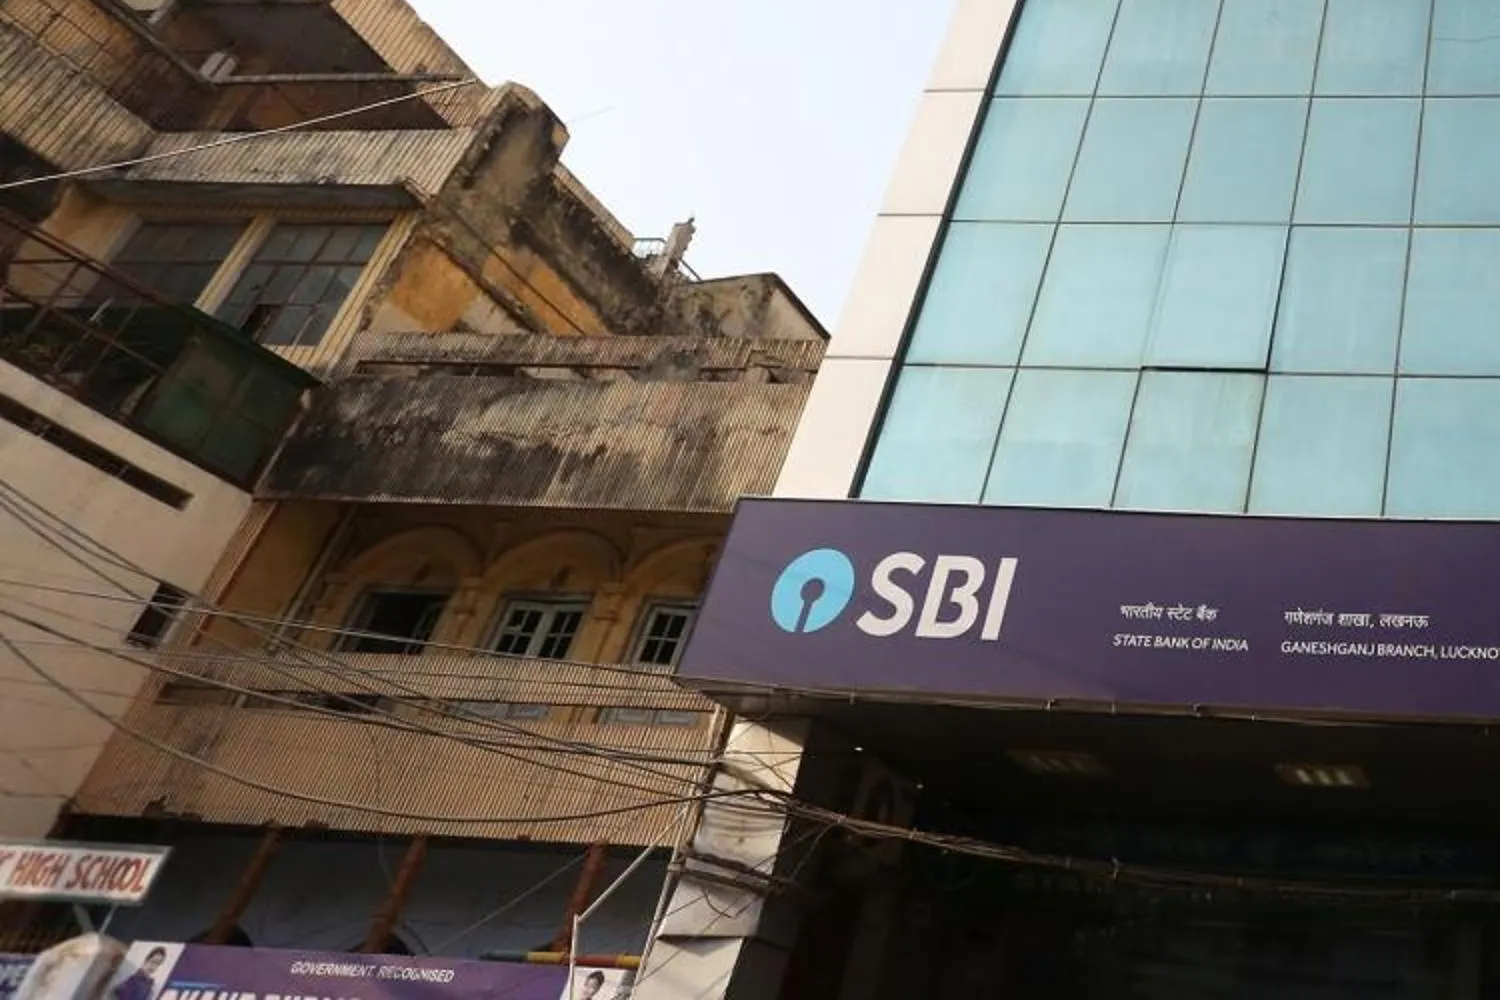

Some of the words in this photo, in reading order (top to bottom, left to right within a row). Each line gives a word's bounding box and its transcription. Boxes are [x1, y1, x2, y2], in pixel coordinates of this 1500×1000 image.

[856, 551, 1018, 640] SBI
[1120, 601, 1164, 620] भारतीय
[1167, 603, 1194, 621] स्टेट
[1197, 603, 1219, 622] बैंक
[1284, 607, 1335, 628] गणेशगंज
[1338, 612, 1375, 629] शाखा,
[1379, 613, 1430, 630] लखनऊ
[1112, 633, 1152, 648] STATE
[1154, 635, 1190, 649] BANK
[1191, 637, 1211, 650] OF
[1211, 637, 1249, 651] INDIA
[1281, 641, 1375, 656] GANESHGANJ
[1377, 643, 1438, 660] BRANCH,
[7, 851, 70, 887] HIGH
[65, 853, 152, 892] SCHOOL
[291, 961, 375, 978] GOVERNMENT
[376, 965, 455, 983] RECOGNISED
